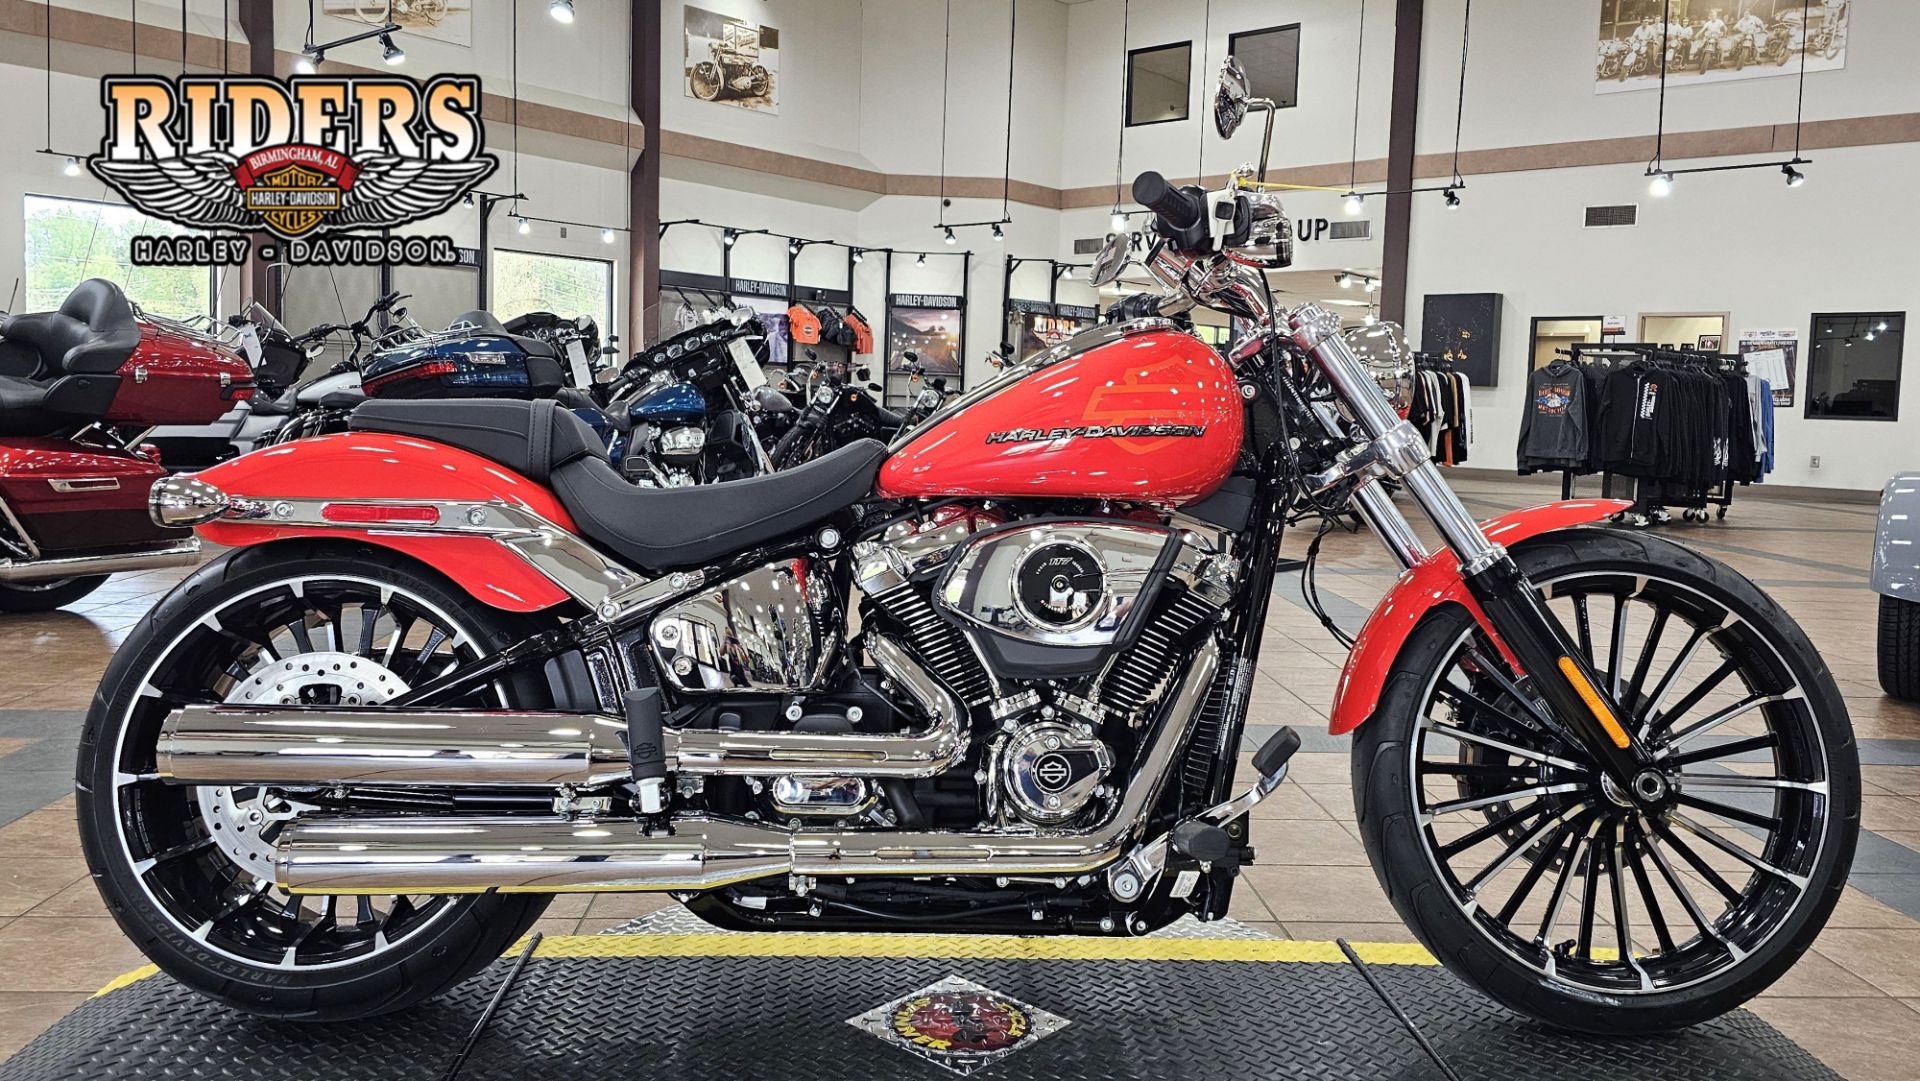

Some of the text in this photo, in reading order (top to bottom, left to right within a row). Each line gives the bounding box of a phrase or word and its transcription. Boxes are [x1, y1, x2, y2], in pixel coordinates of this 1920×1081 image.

[1297, 218, 1329, 242] UP
[735, 279, 787, 297] HARLEY-DAVIDSON
[895, 294, 957, 308] HARLEY-DAVIDSON
[987, 425, 1208, 445] HARLEY-DAVIDSON
